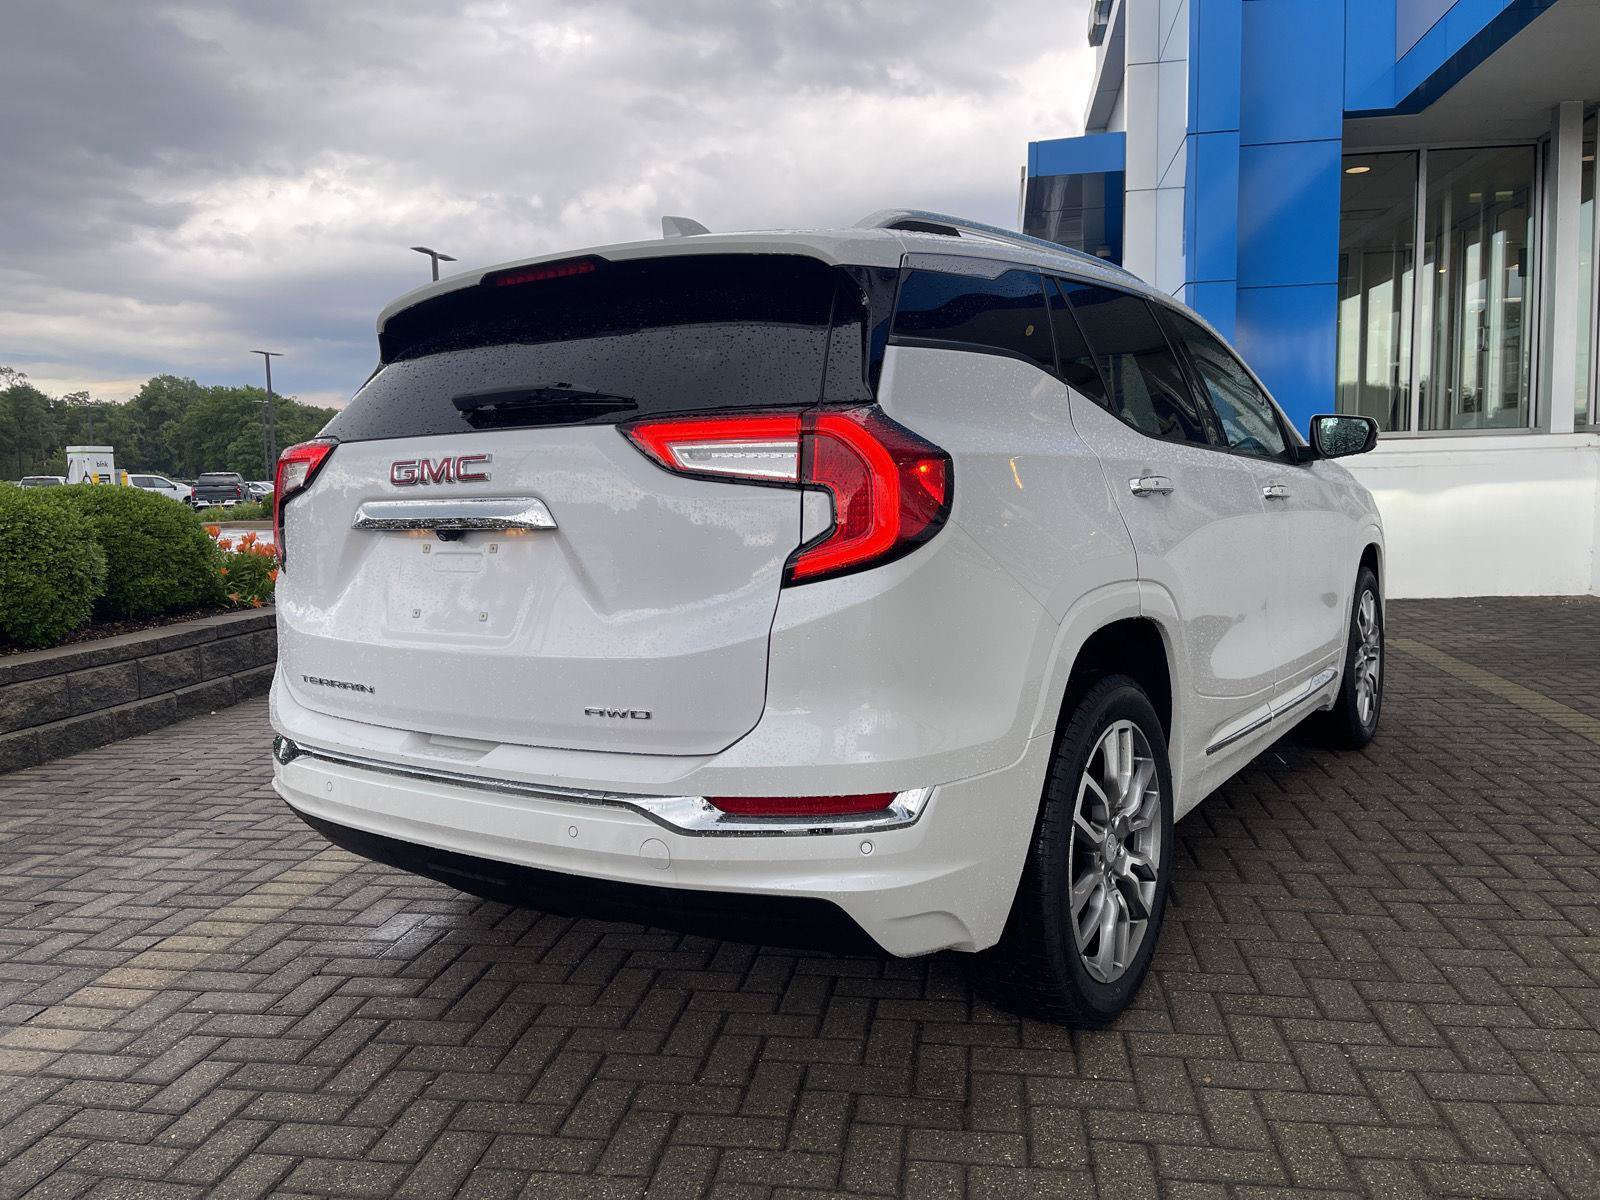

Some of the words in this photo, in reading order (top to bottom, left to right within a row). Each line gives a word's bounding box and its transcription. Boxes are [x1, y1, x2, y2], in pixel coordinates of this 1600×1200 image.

[390, 454, 492, 487] GMC
[300, 674, 375, 694] TERRAIN
[584, 706, 652, 720] AWD
